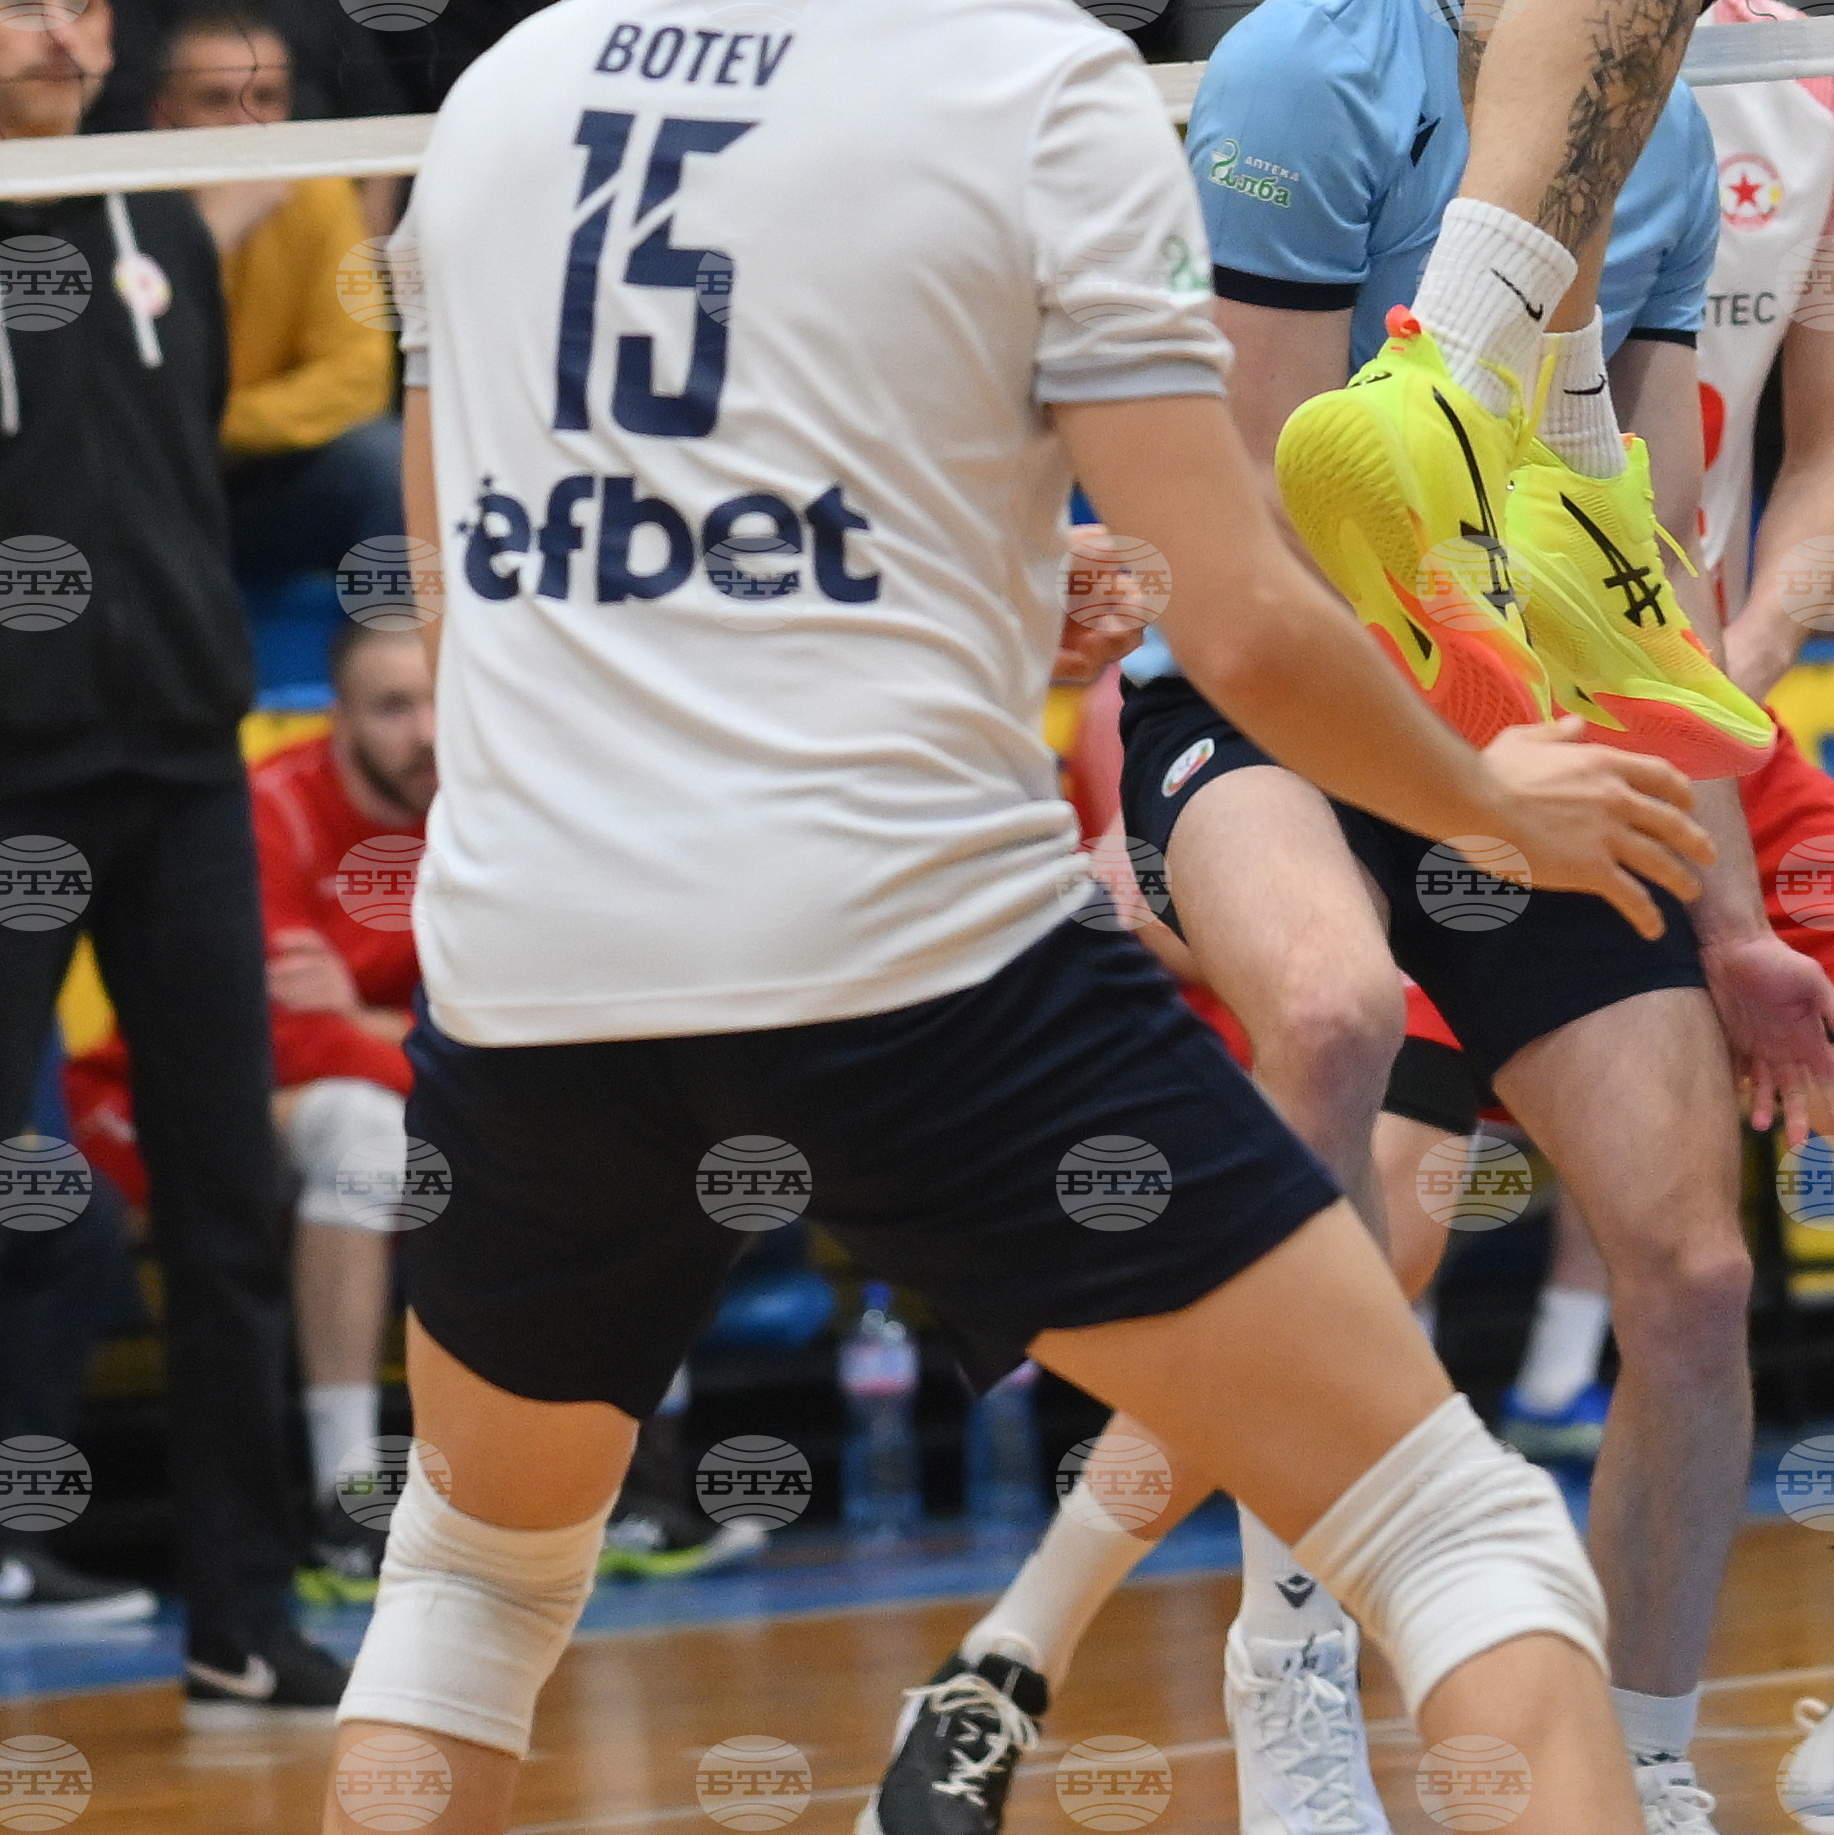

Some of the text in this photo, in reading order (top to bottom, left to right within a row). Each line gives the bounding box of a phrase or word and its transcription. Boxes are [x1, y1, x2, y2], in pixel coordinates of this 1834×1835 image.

[594, 23, 798, 88] BOTEV
[551, 109, 761, 438] 15
[1702, 291, 1776, 327] TEC
[464, 474, 881, 606] efbet
